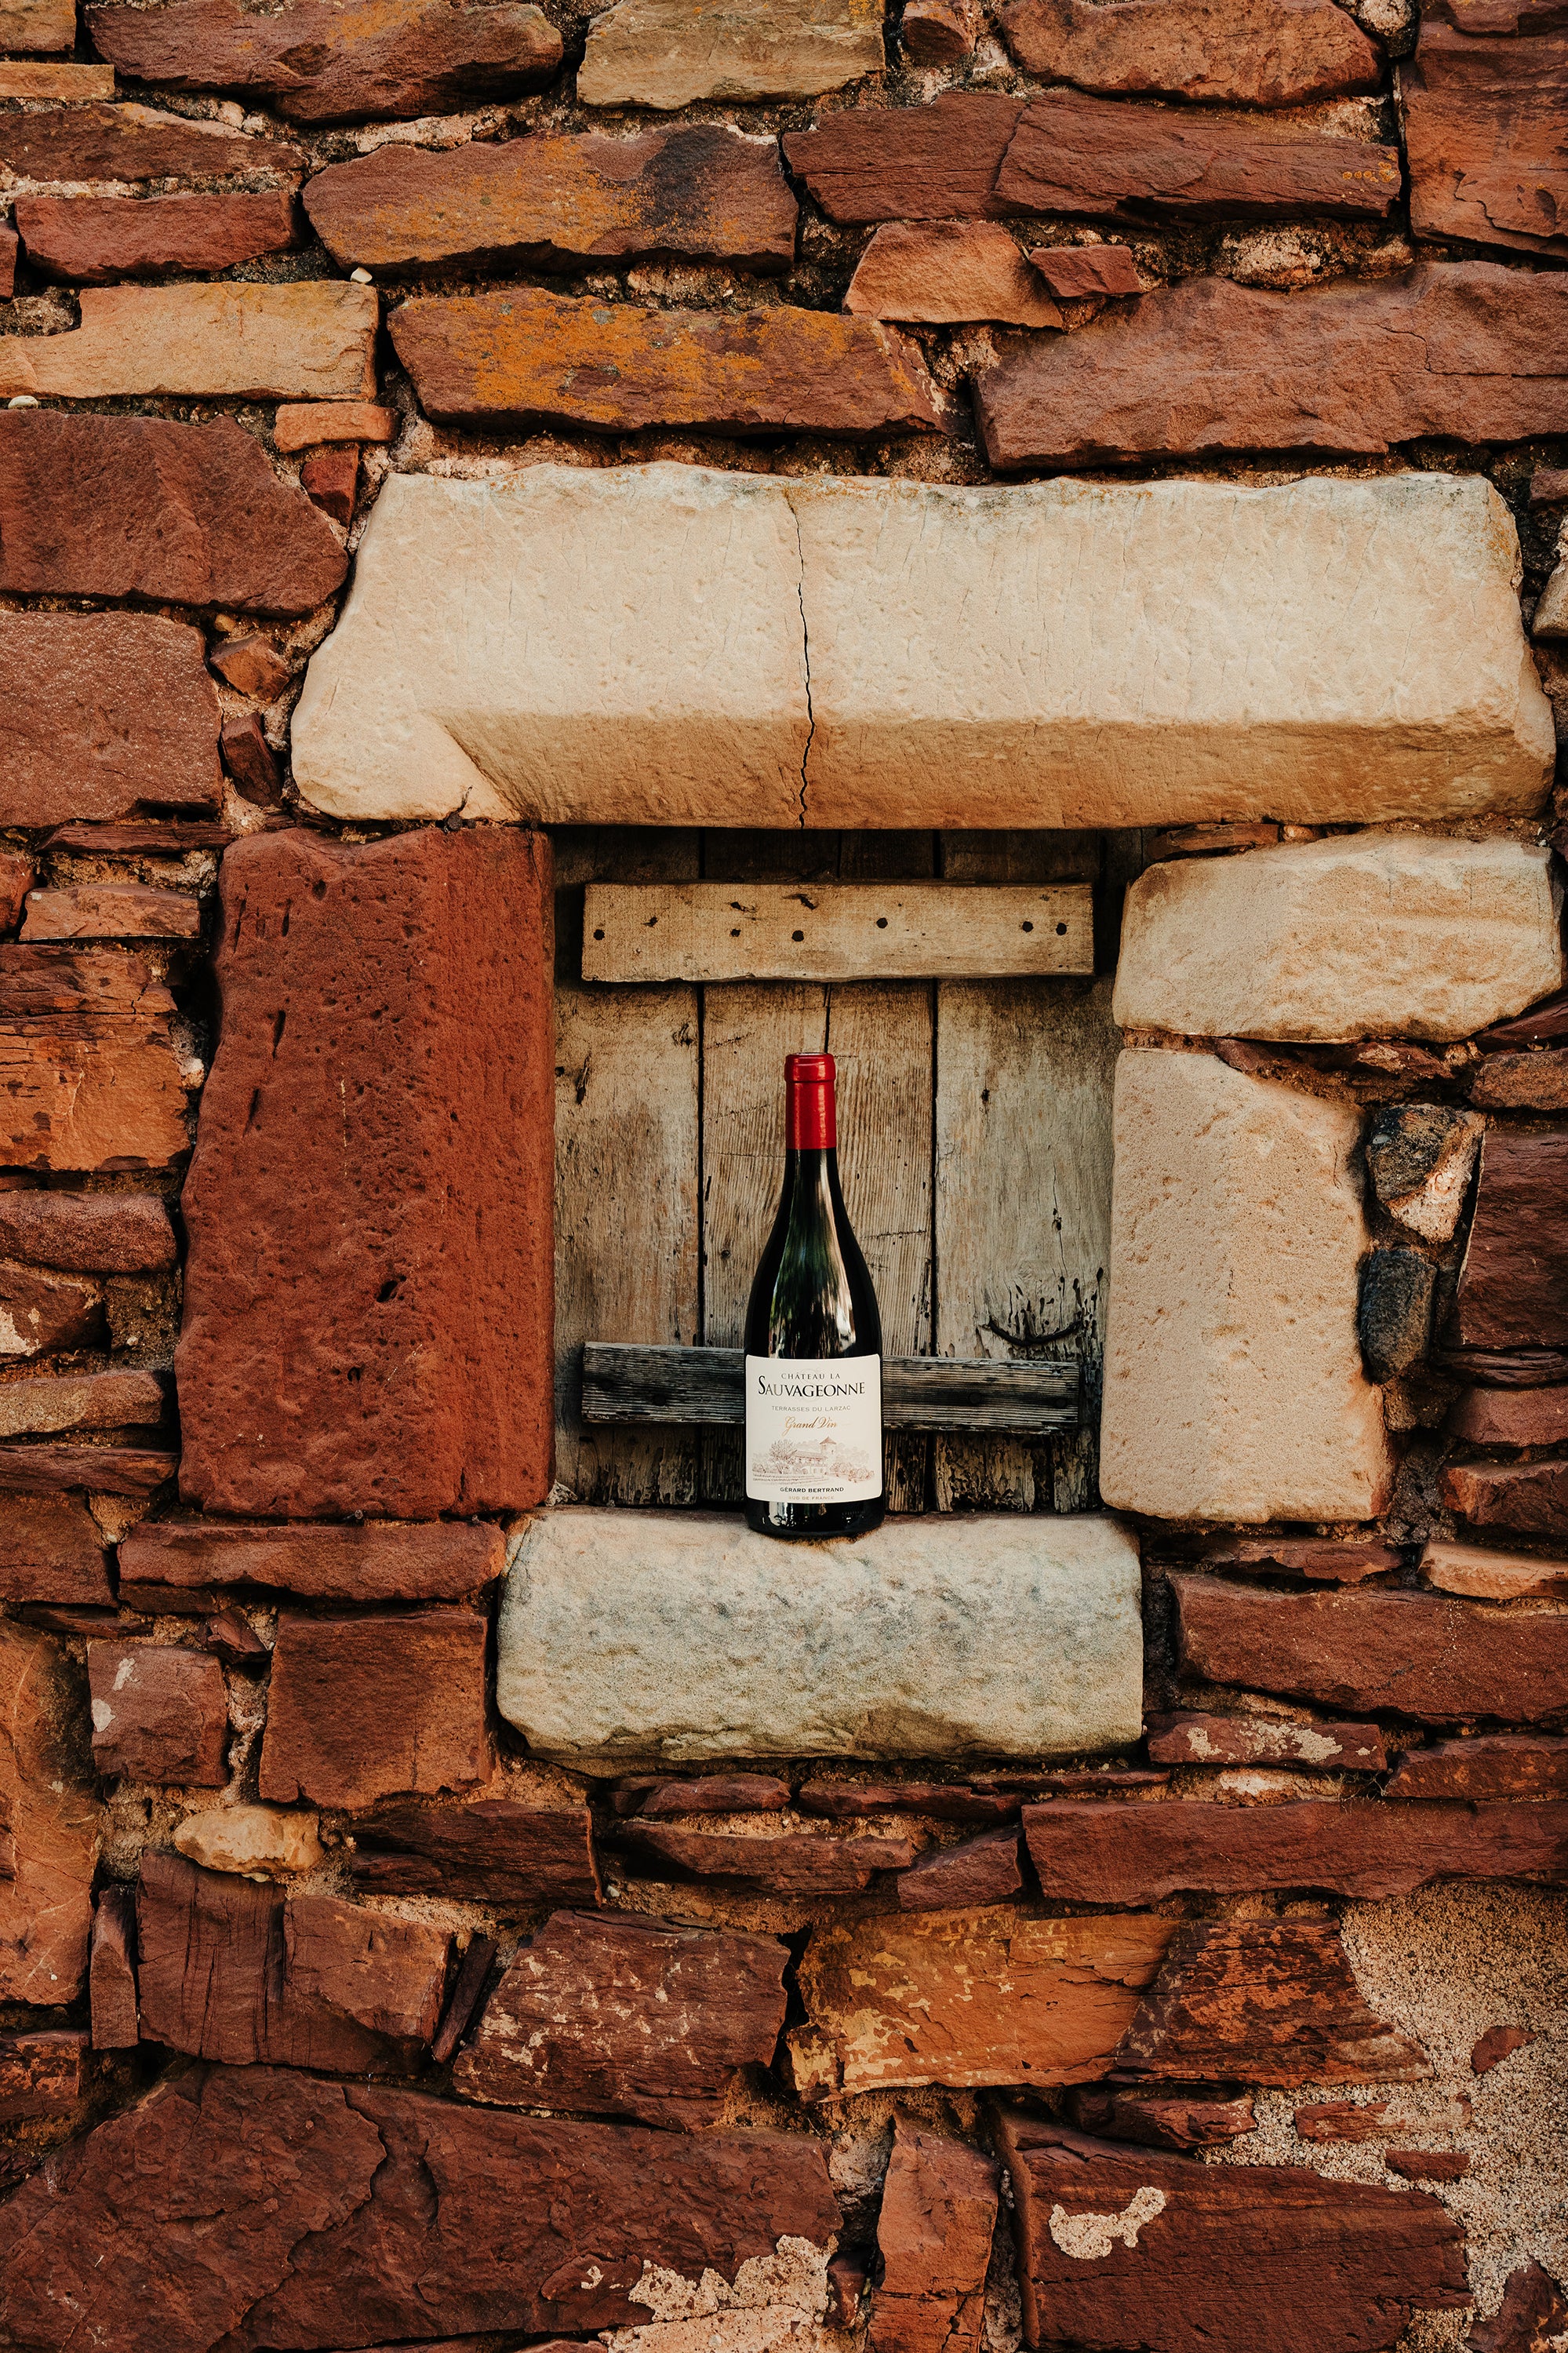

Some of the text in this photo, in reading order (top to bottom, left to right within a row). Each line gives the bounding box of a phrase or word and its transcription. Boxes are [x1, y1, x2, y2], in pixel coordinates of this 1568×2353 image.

[758, 1375, 865, 1397] SAUVAGEONNE
[782, 1417, 837, 1437] Grand Vin
